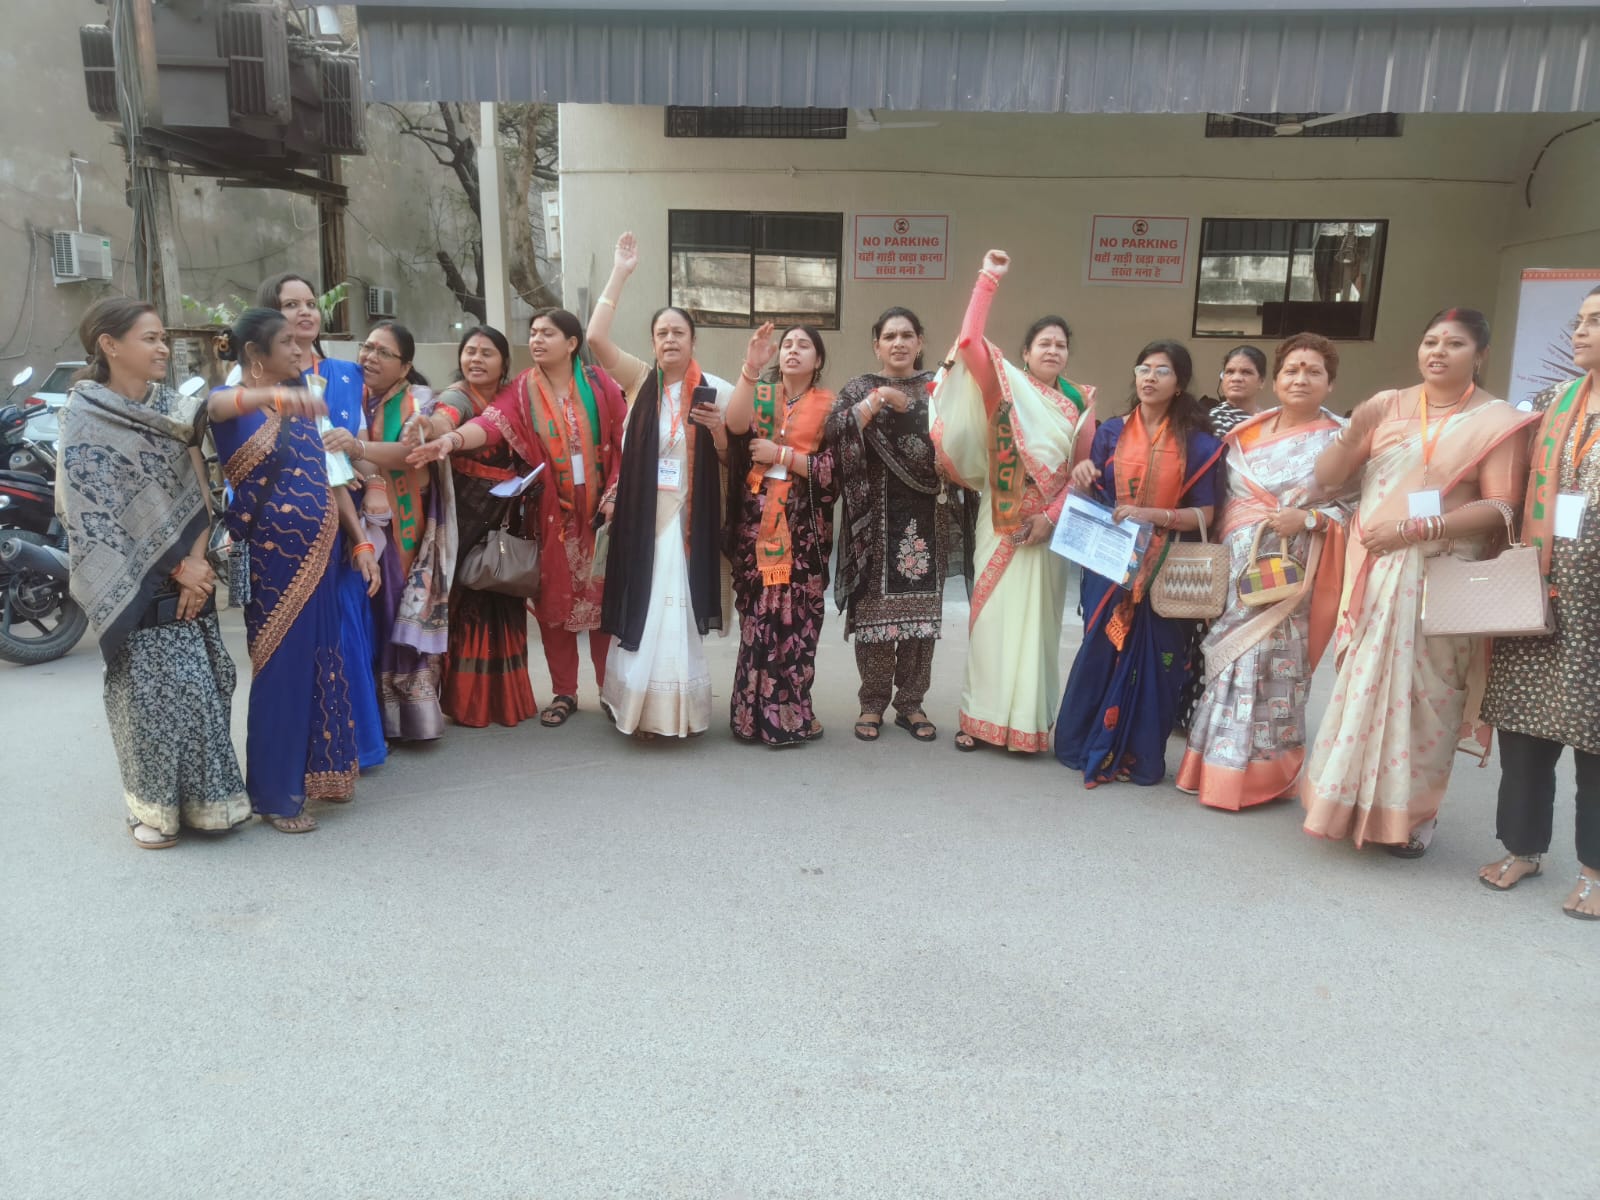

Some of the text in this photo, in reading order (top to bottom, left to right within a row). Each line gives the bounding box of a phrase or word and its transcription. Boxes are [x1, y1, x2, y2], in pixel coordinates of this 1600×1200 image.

[863, 236, 940, 247] NO PARKING
[1099, 238, 1178, 249] NO PARKING
